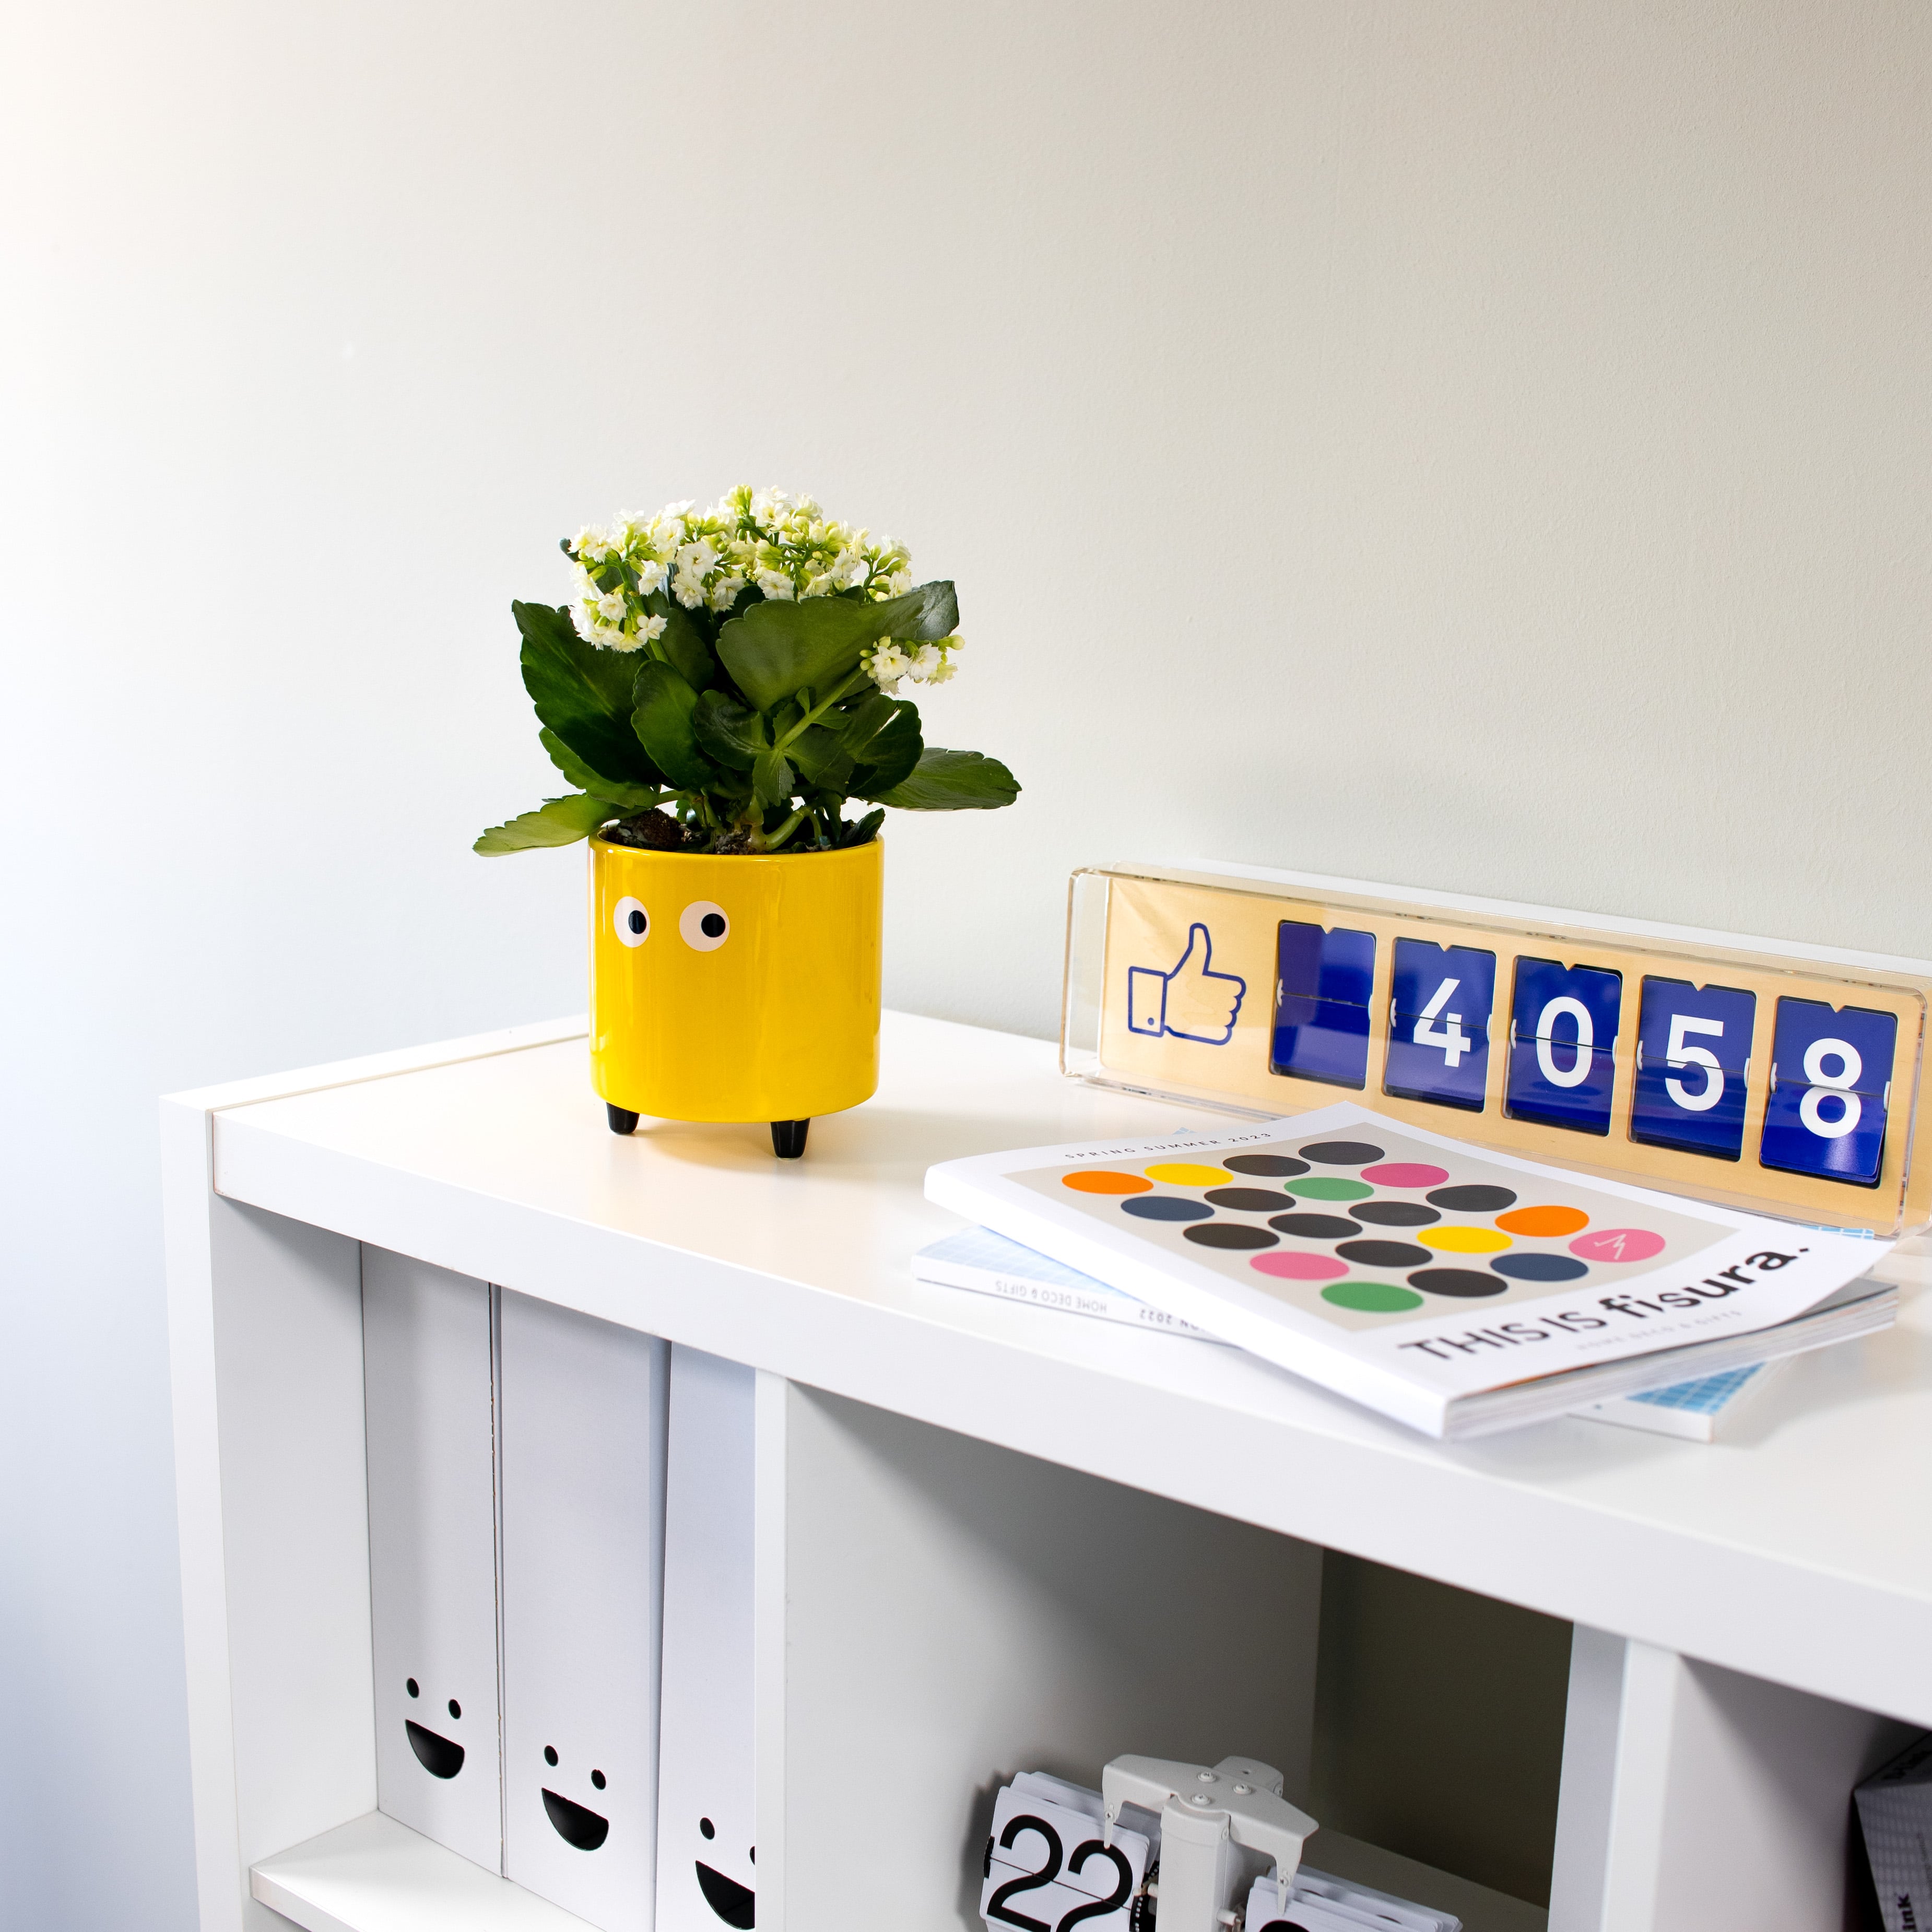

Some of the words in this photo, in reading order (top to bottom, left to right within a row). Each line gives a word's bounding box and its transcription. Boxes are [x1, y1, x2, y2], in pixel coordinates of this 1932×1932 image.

[1065, 1148, 1136, 1159] SPRING
[1144, 1140, 1221, 1151] SUMMER
[1228, 1132, 1271, 1143] 2023
[995, 1280, 1028, 1297] GIFTS
[1041, 1290, 1072, 1306] DECO
[1075, 1296, 1107, 1313] HOME
[1397, 1323, 1550, 1359] THIS
[1538, 1311, 1607, 1333] IS
[1598, 1247, 1810, 1318] fisura.
[986, 1814, 1134, 1932] 22
